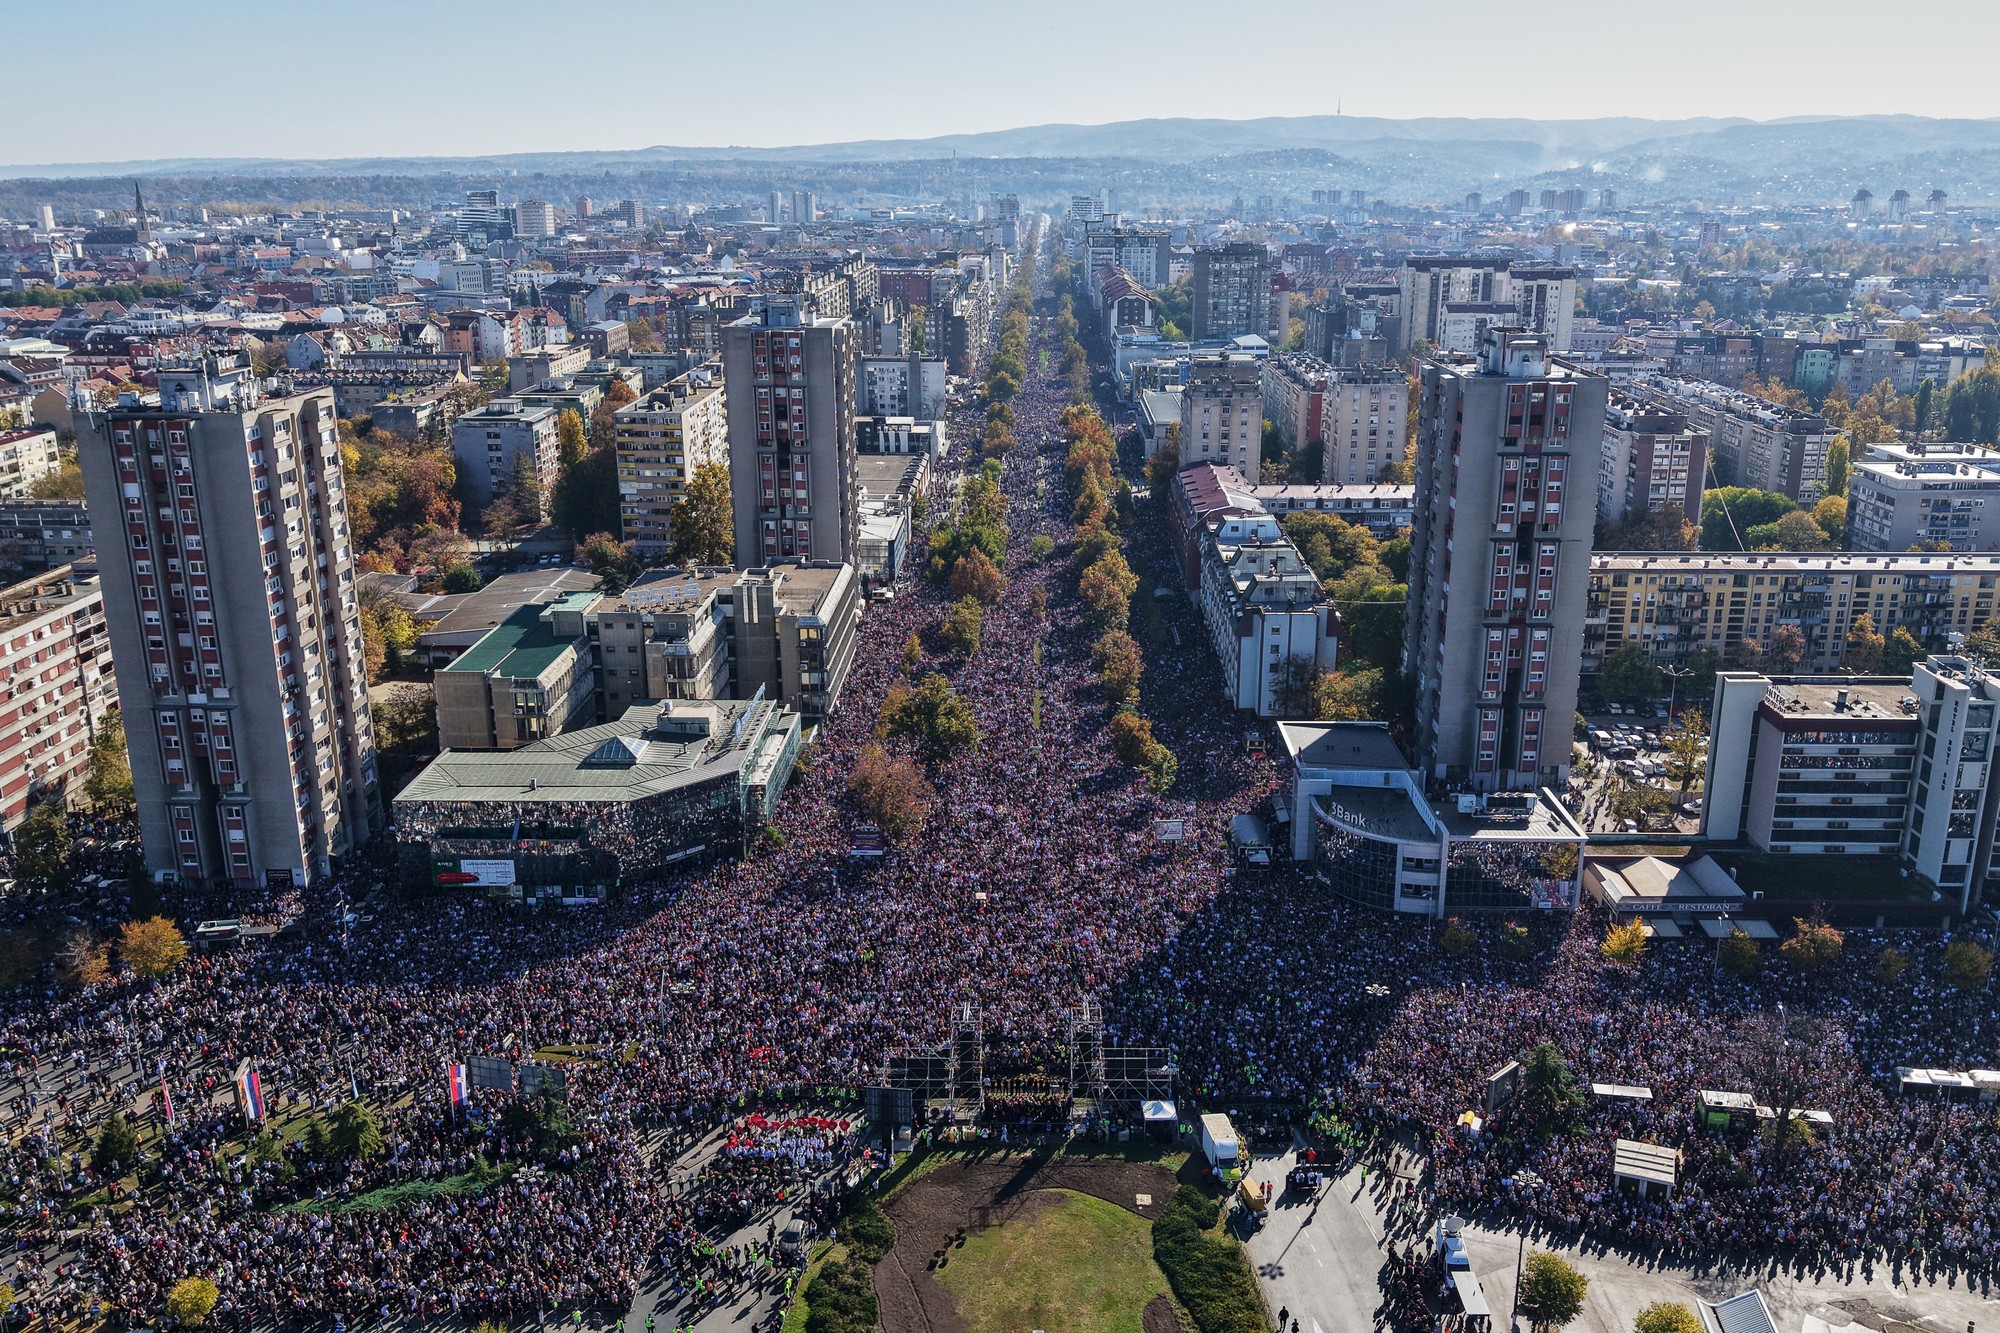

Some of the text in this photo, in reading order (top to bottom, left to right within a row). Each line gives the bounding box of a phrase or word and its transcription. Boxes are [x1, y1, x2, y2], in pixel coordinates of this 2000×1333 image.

[627, 585, 681, 607] ERSTE
[1950, 699, 1959, 733] HOTEL
[1945, 739, 1953, 765] NOVI
[1331, 802, 1367, 827] 3Bank
